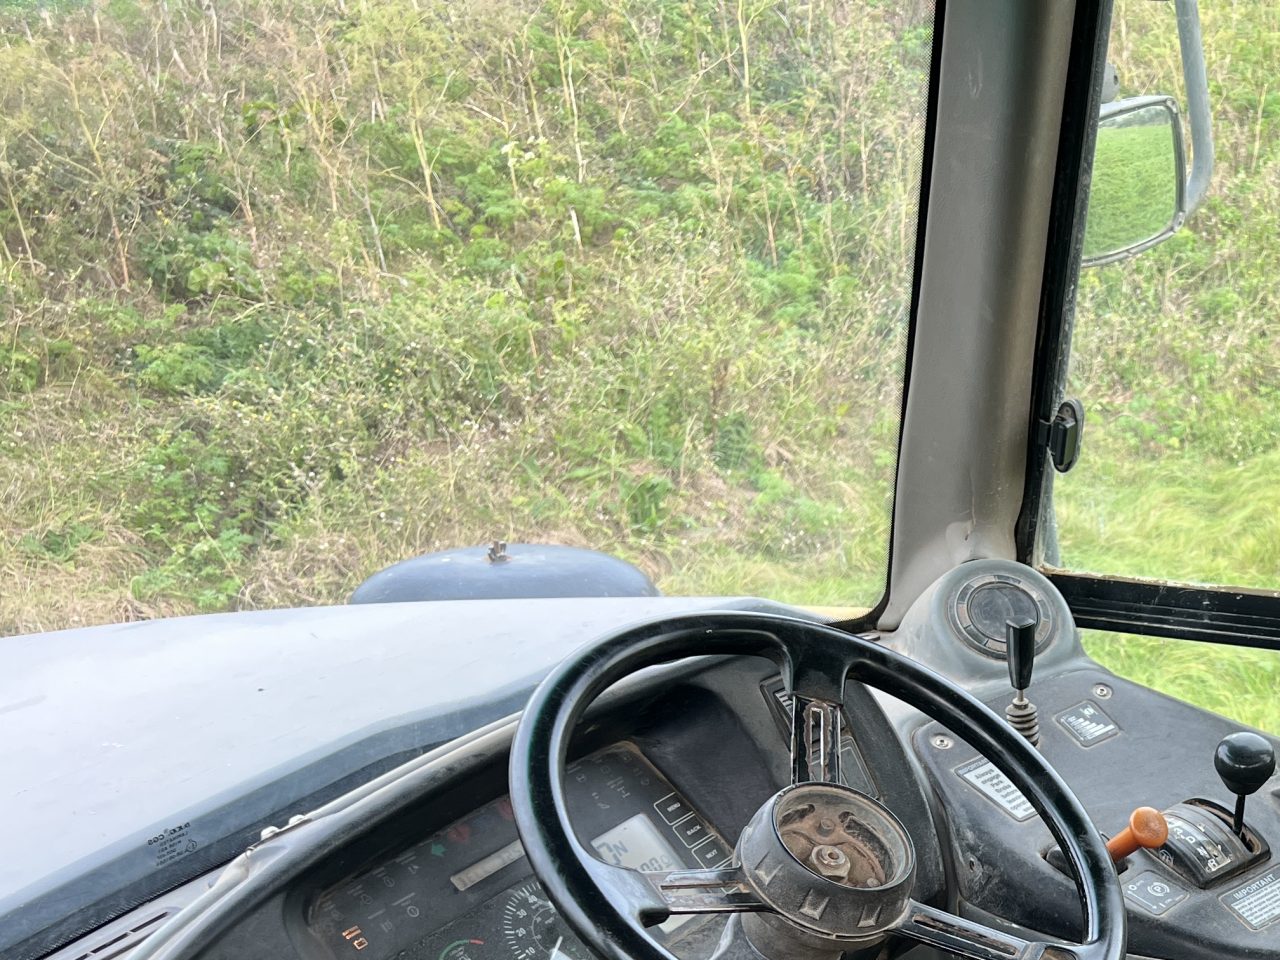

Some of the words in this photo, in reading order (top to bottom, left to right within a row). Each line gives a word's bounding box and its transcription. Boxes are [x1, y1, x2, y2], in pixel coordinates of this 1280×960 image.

[667, 802, 681, 812] MENU
[686, 825, 701, 836] BACK
[705, 849, 718, 859] NEXT
[1233, 874, 1276, 900] IMPORTANT
[516, 908, 527, 918] 30
[516, 927, 526, 937] 20
[525, 946, 536, 956] 10
